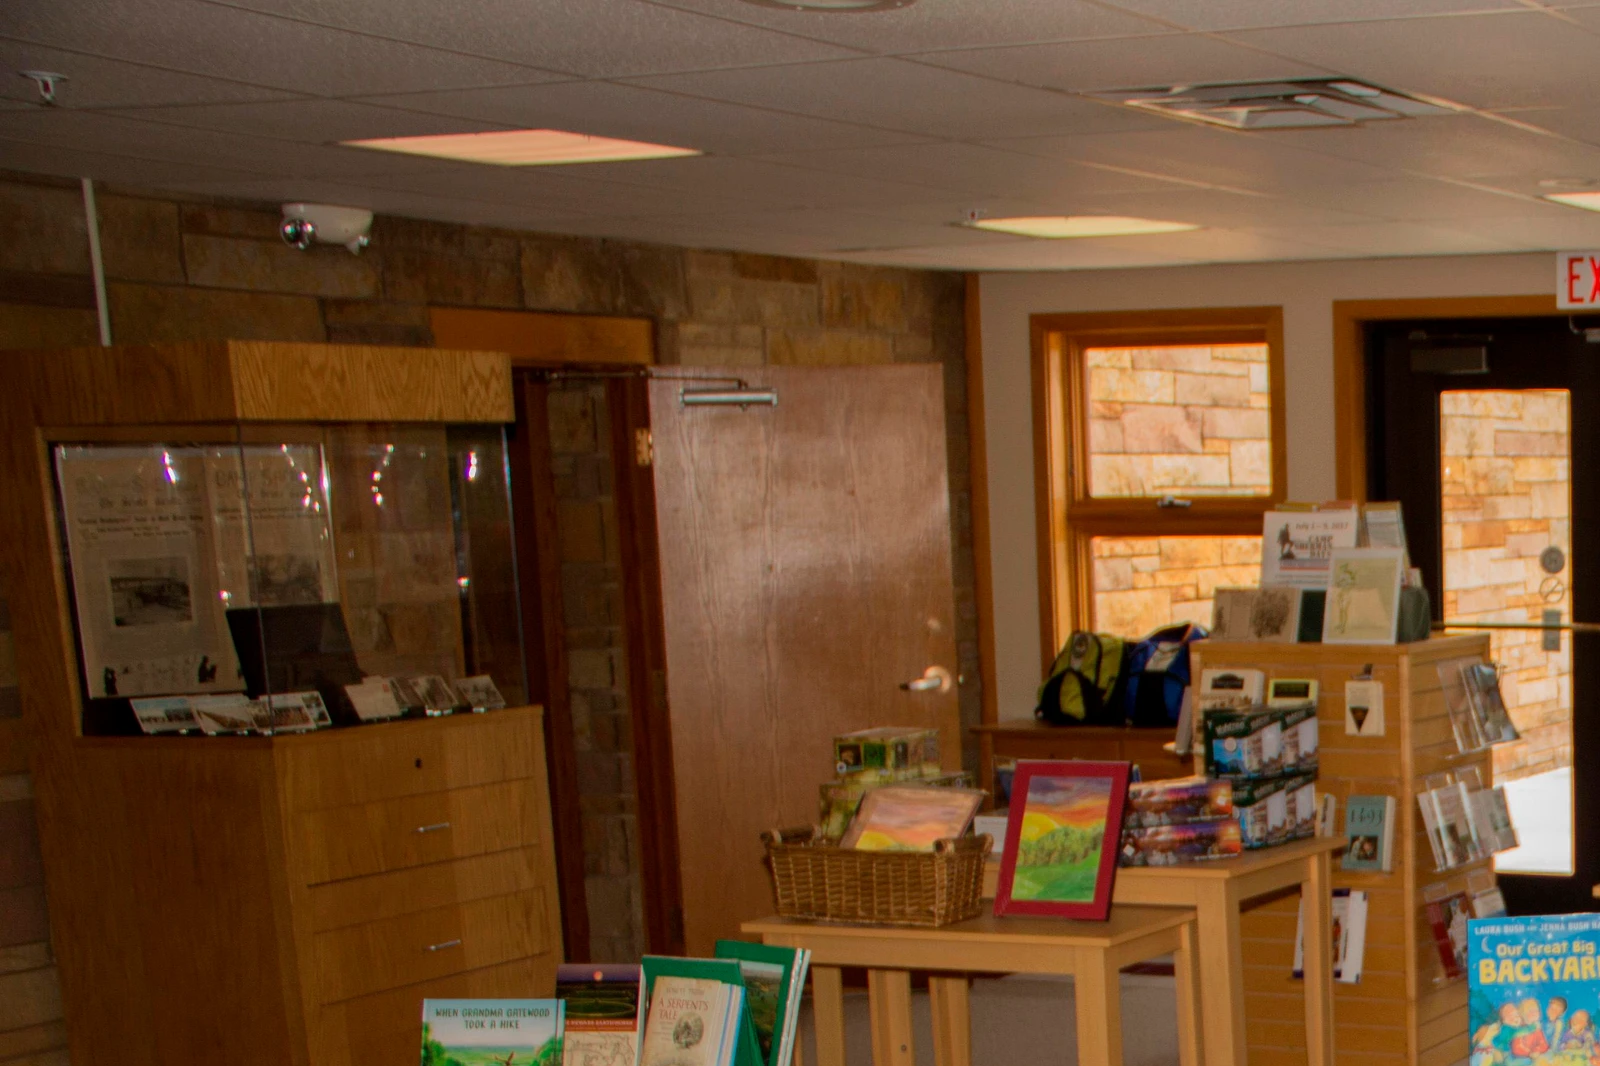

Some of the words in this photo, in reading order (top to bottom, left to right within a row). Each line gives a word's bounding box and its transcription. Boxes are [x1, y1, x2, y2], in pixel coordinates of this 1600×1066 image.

[1474, 924, 1502, 936] LAURA
[1504, 923, 1525, 934] BUSH
[1540, 922, 1566, 932] JENNA
[1568, 921, 1590, 931] BUSH
[1496, 943, 1524, 957] Our
[1527, 941, 1569, 956] Great
[1572, 940, 1596, 955] Big
[659, 998, 666, 1007] A
[435, 1008, 459, 1018] WHEN
[462, 1008, 504, 1018] GRANDMA
[506, 1008, 551, 1018] GATEWOOD
[658, 1009, 678, 1020] TALE
[465, 1020, 486, 1030] TOOK
[490, 1020, 497, 1029] A
[500, 1020, 521, 1029] HIKE
